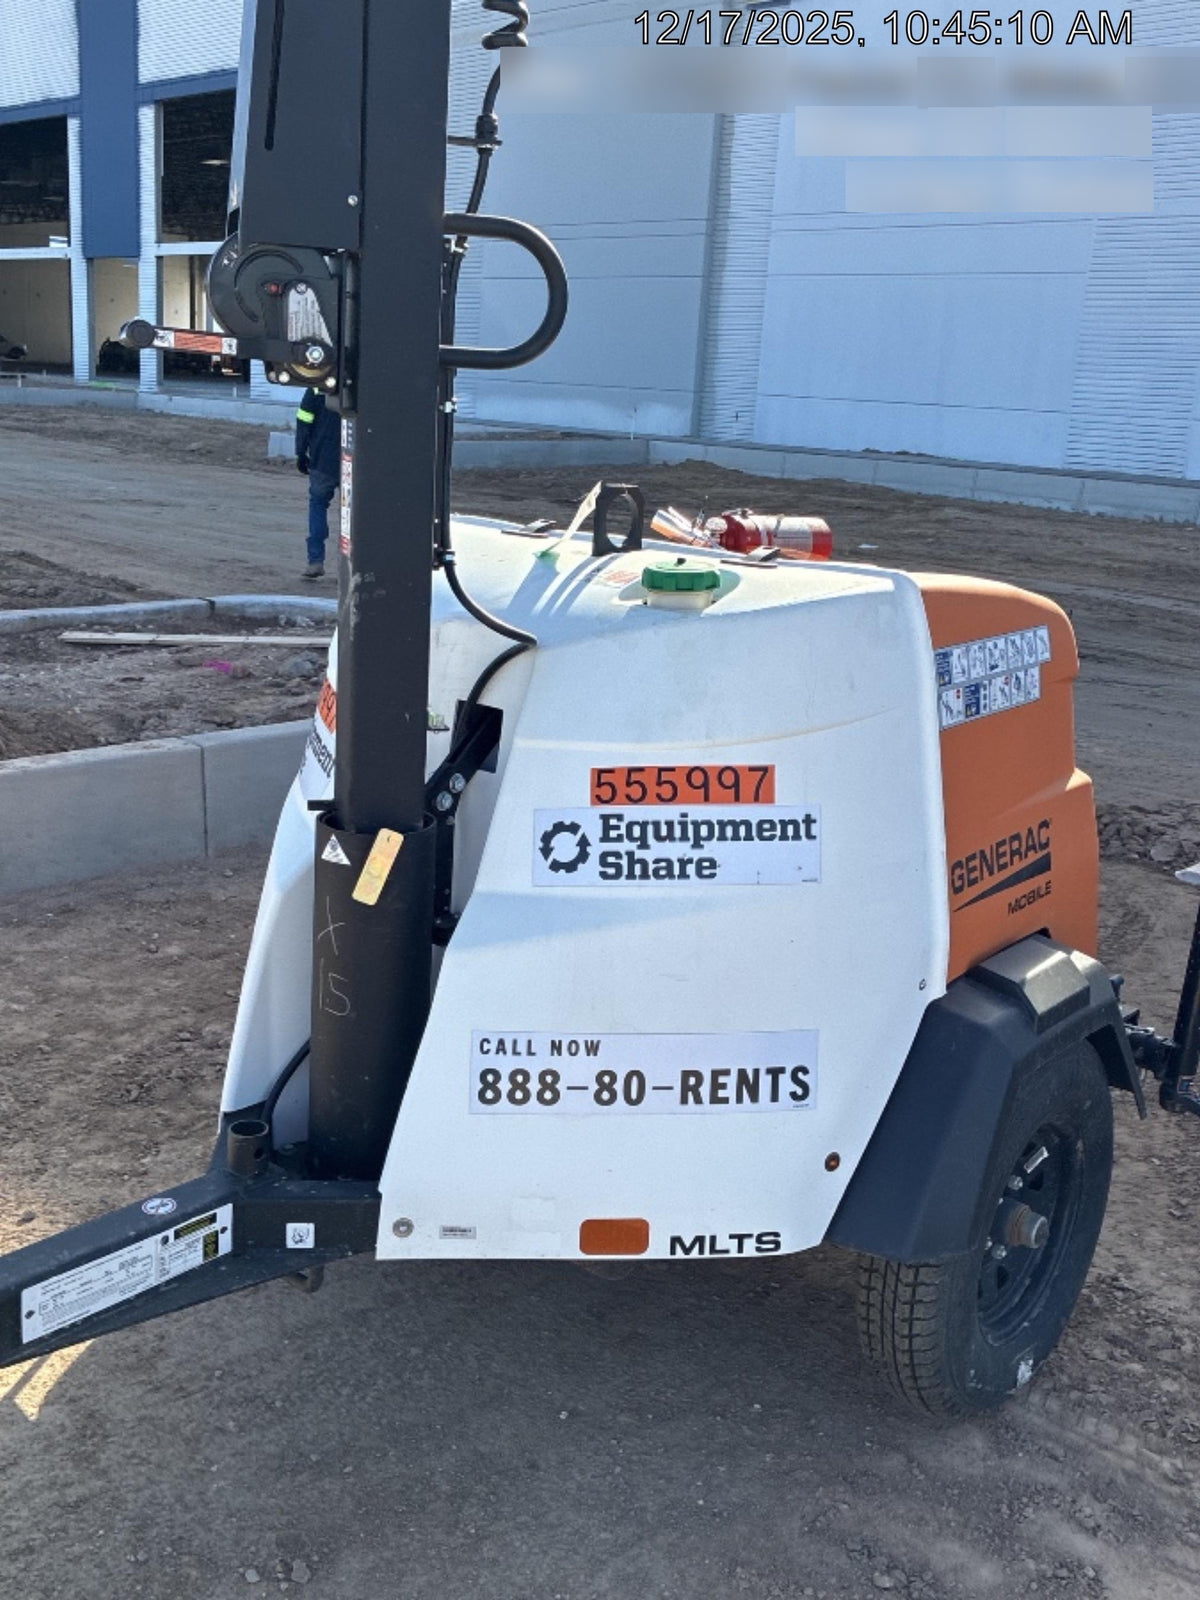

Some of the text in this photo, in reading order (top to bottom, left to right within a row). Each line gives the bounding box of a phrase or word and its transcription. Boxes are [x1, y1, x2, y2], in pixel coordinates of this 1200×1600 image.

[594, 766, 769, 804] 555997
[598, 812, 818, 850] Equipment
[598, 850, 718, 881] Share
[950, 818, 1051, 896] GENERAC
[1007, 880, 1052, 915] MOBILE
[478, 1037, 602, 1057] CALL NOW
[477, 1065, 811, 1107] 888-80-RENTS
[669, 1231, 782, 1256] MLTS
